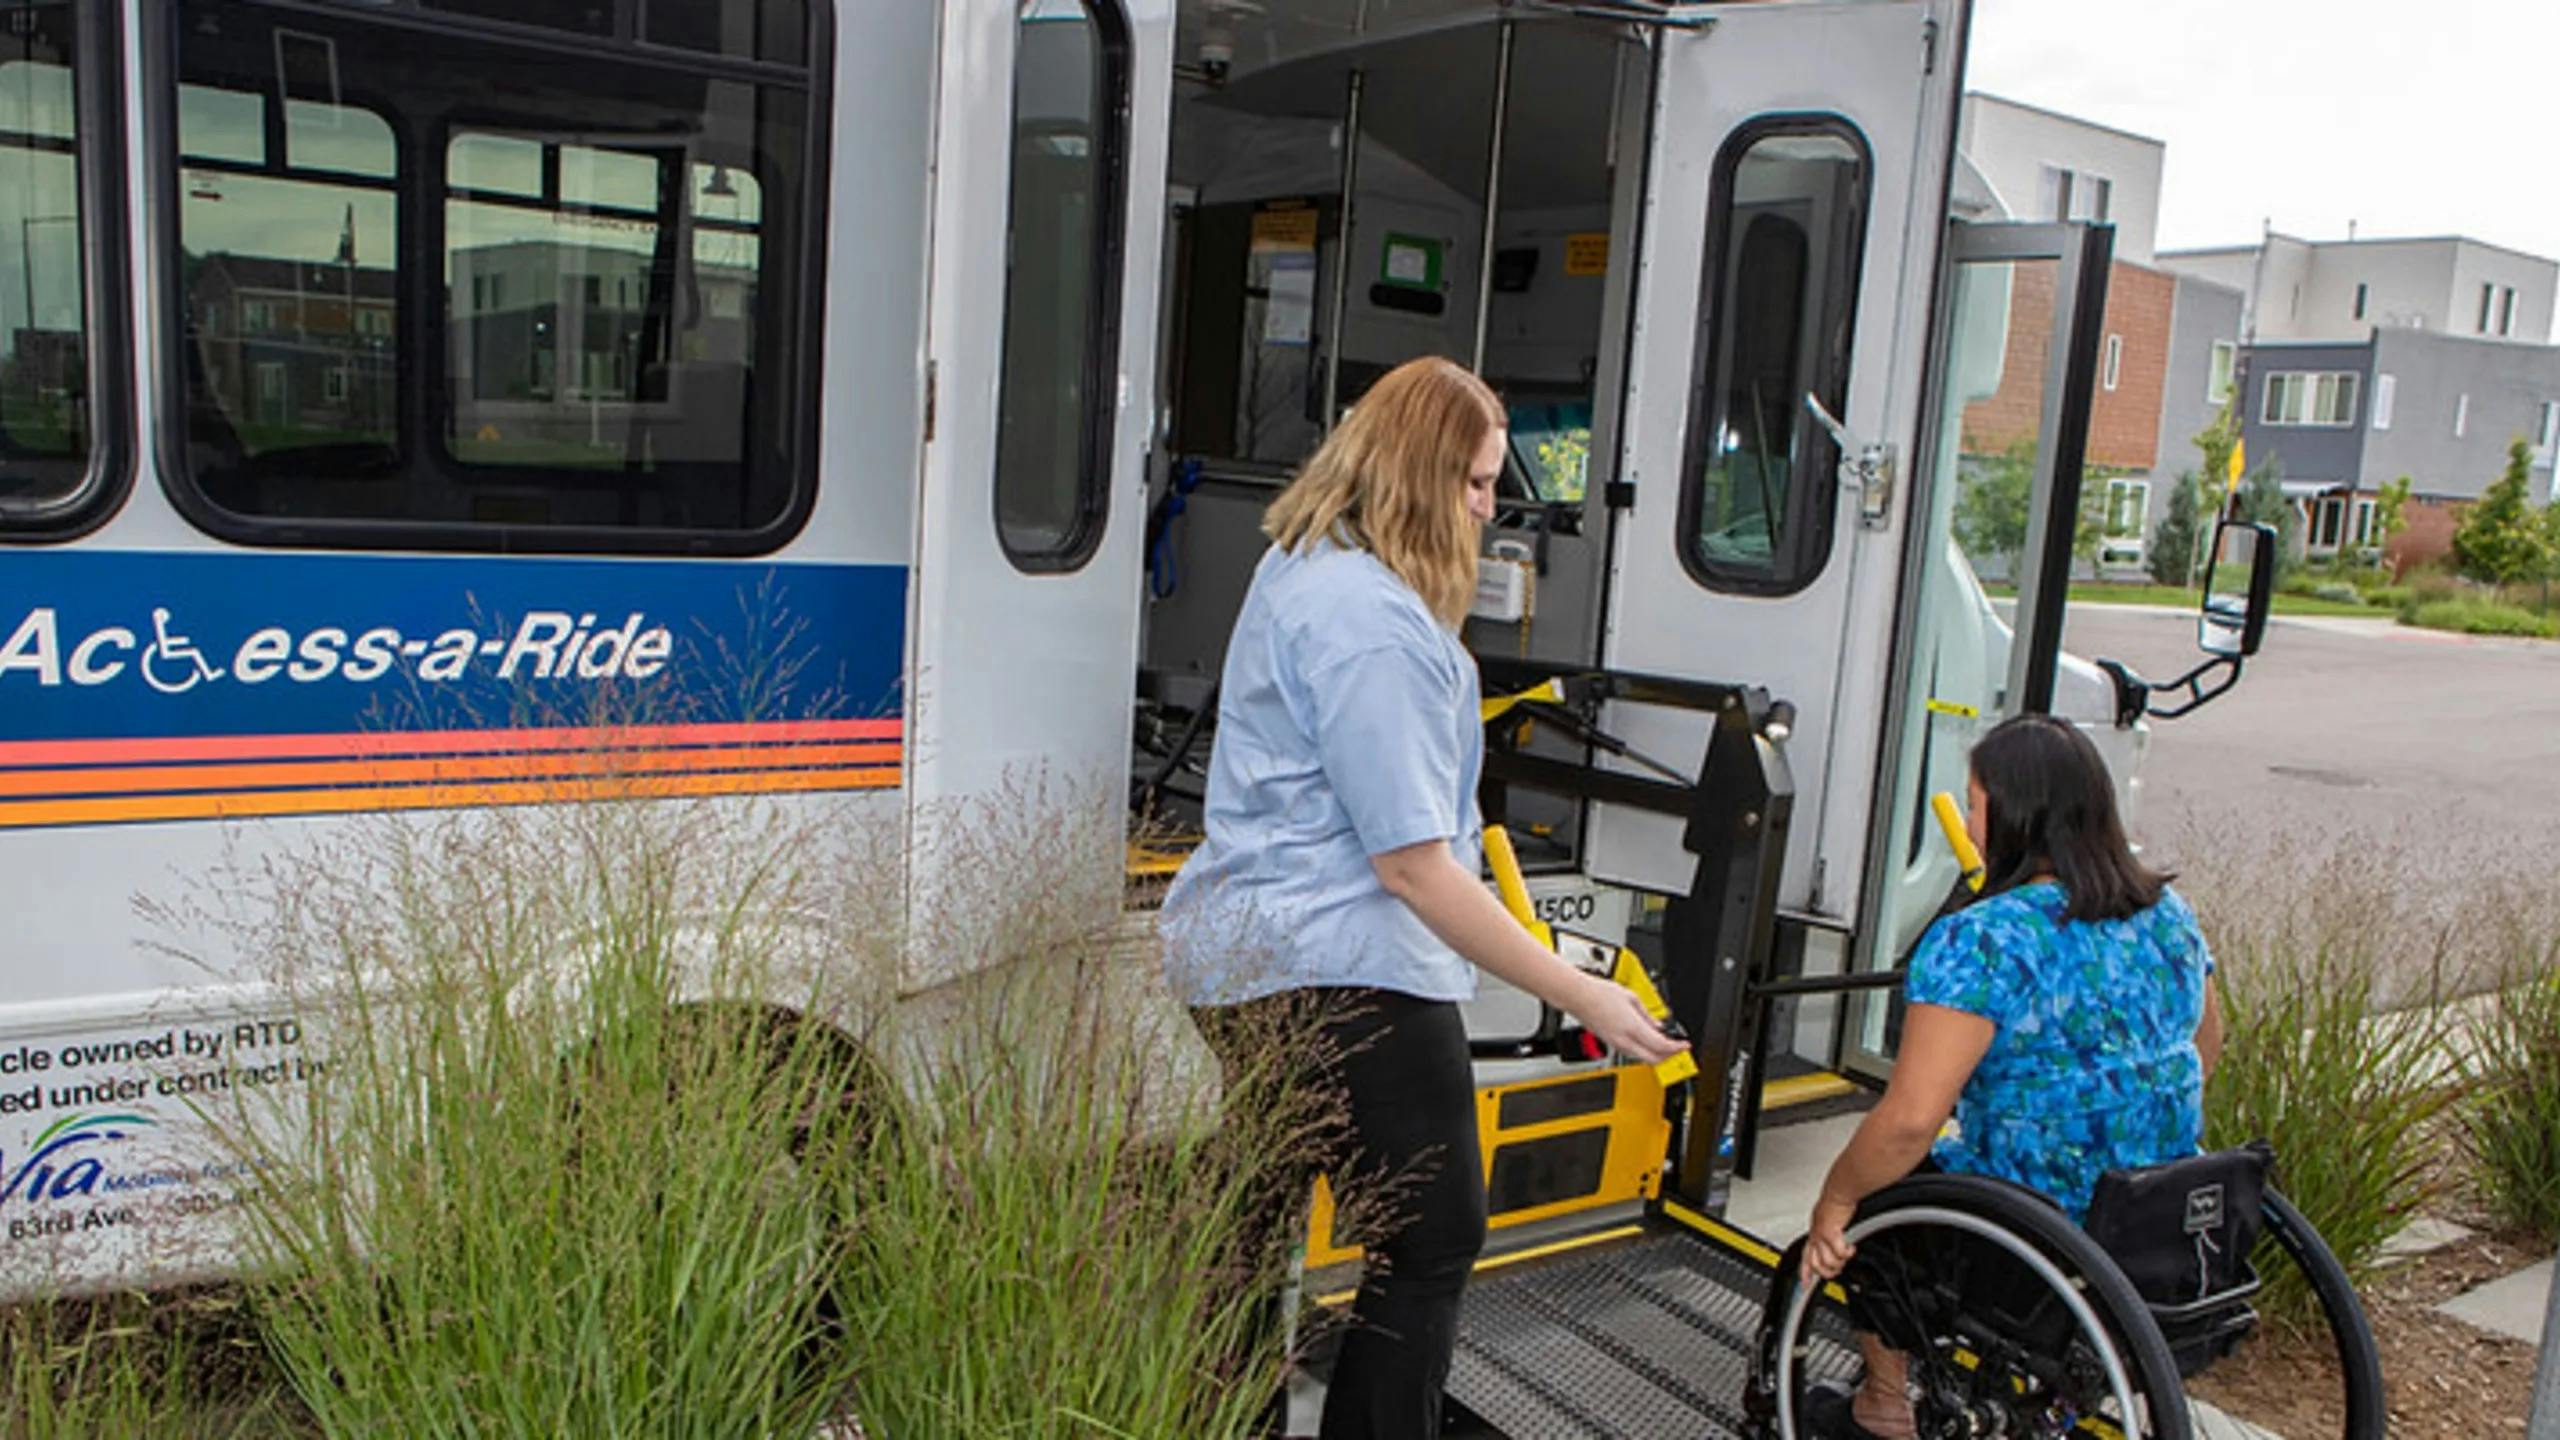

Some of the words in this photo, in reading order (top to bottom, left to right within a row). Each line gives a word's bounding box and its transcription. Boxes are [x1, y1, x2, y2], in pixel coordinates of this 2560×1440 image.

[0, 1046, 52, 1074] cle
[60, 1031, 174, 1068] owned
[184, 1029, 222, 1058] by
[234, 1019, 301, 1049] RTD
[0, 1084, 42, 1113] ed
[51, 1077, 150, 1108] under
[9, 1209, 75, 1240] 63rd
